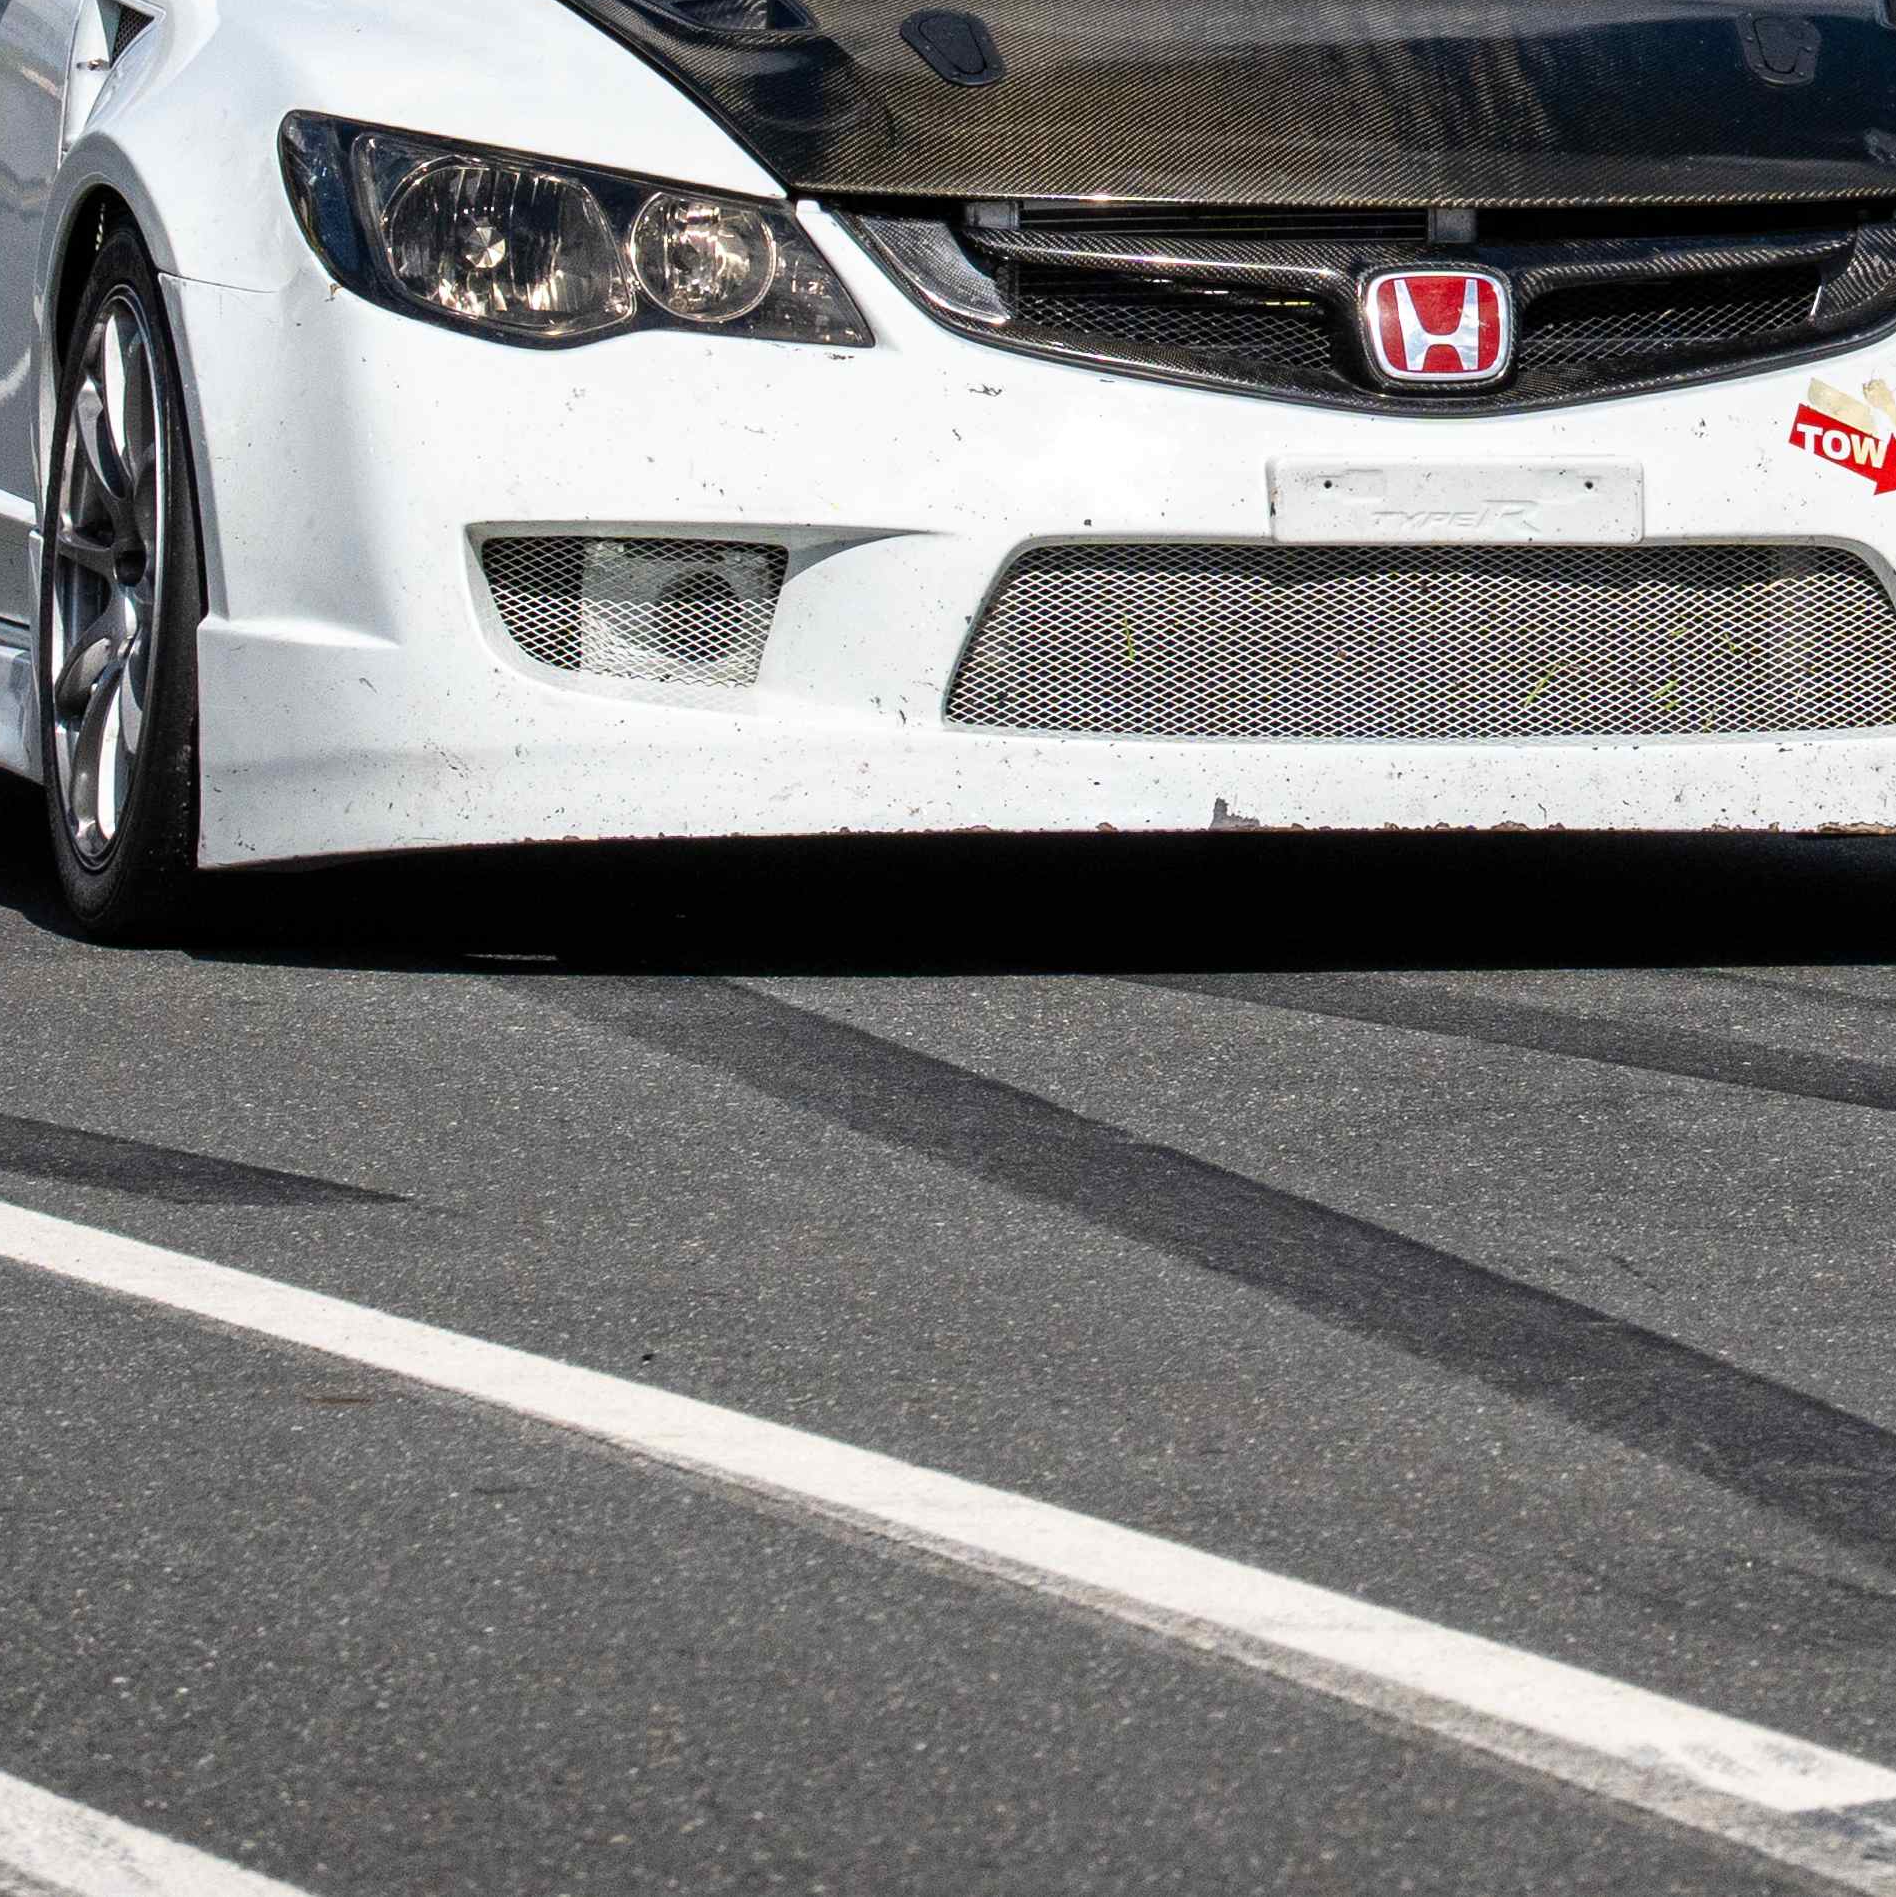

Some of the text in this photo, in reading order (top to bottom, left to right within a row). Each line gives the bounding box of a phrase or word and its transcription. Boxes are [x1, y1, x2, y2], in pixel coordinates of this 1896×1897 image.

[1796, 423, 1892, 469] TOW
[1371, 499, 1543, 533] TYPE R
